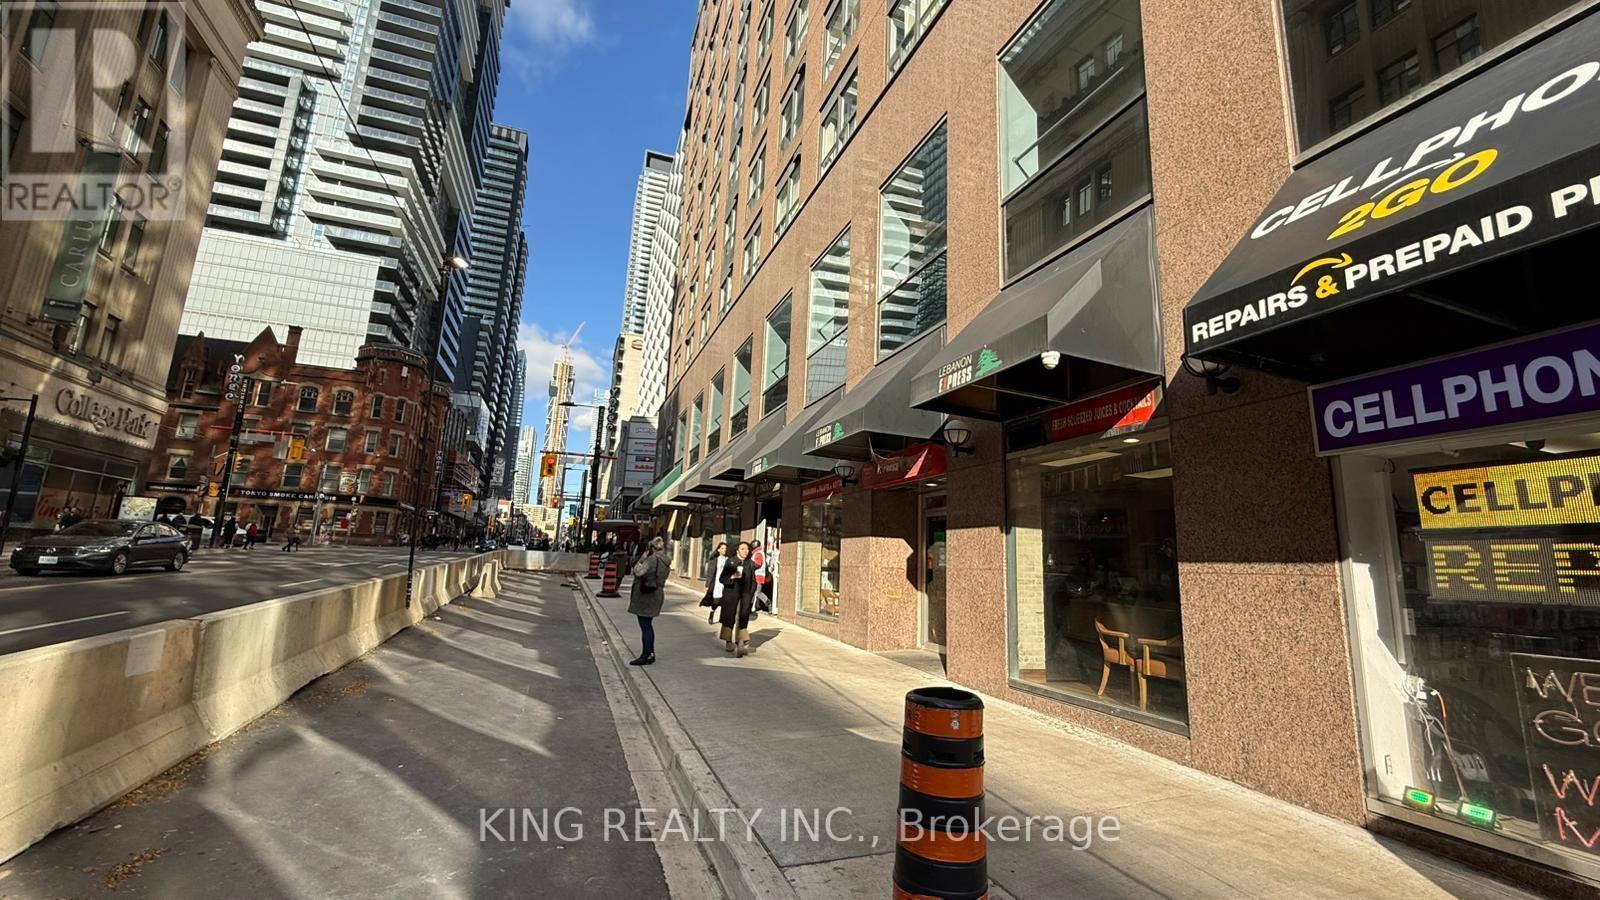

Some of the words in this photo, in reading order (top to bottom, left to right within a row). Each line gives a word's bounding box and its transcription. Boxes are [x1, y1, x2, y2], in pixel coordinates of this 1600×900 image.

[1251, 61, 1600, 240] CELLPHO
[1326, 149, 1498, 240] 2GO
[1191, 285, 1308, 343] REPAIRS
[1315, 275, 1340, 299] &
[1344, 205, 1533, 290] PREPAID
[938, 354, 973, 378] LEBANON
[56, 387, 116, 433] College
[115, 406, 152, 440] Park
[1420, 472, 1600, 515] CELLP
